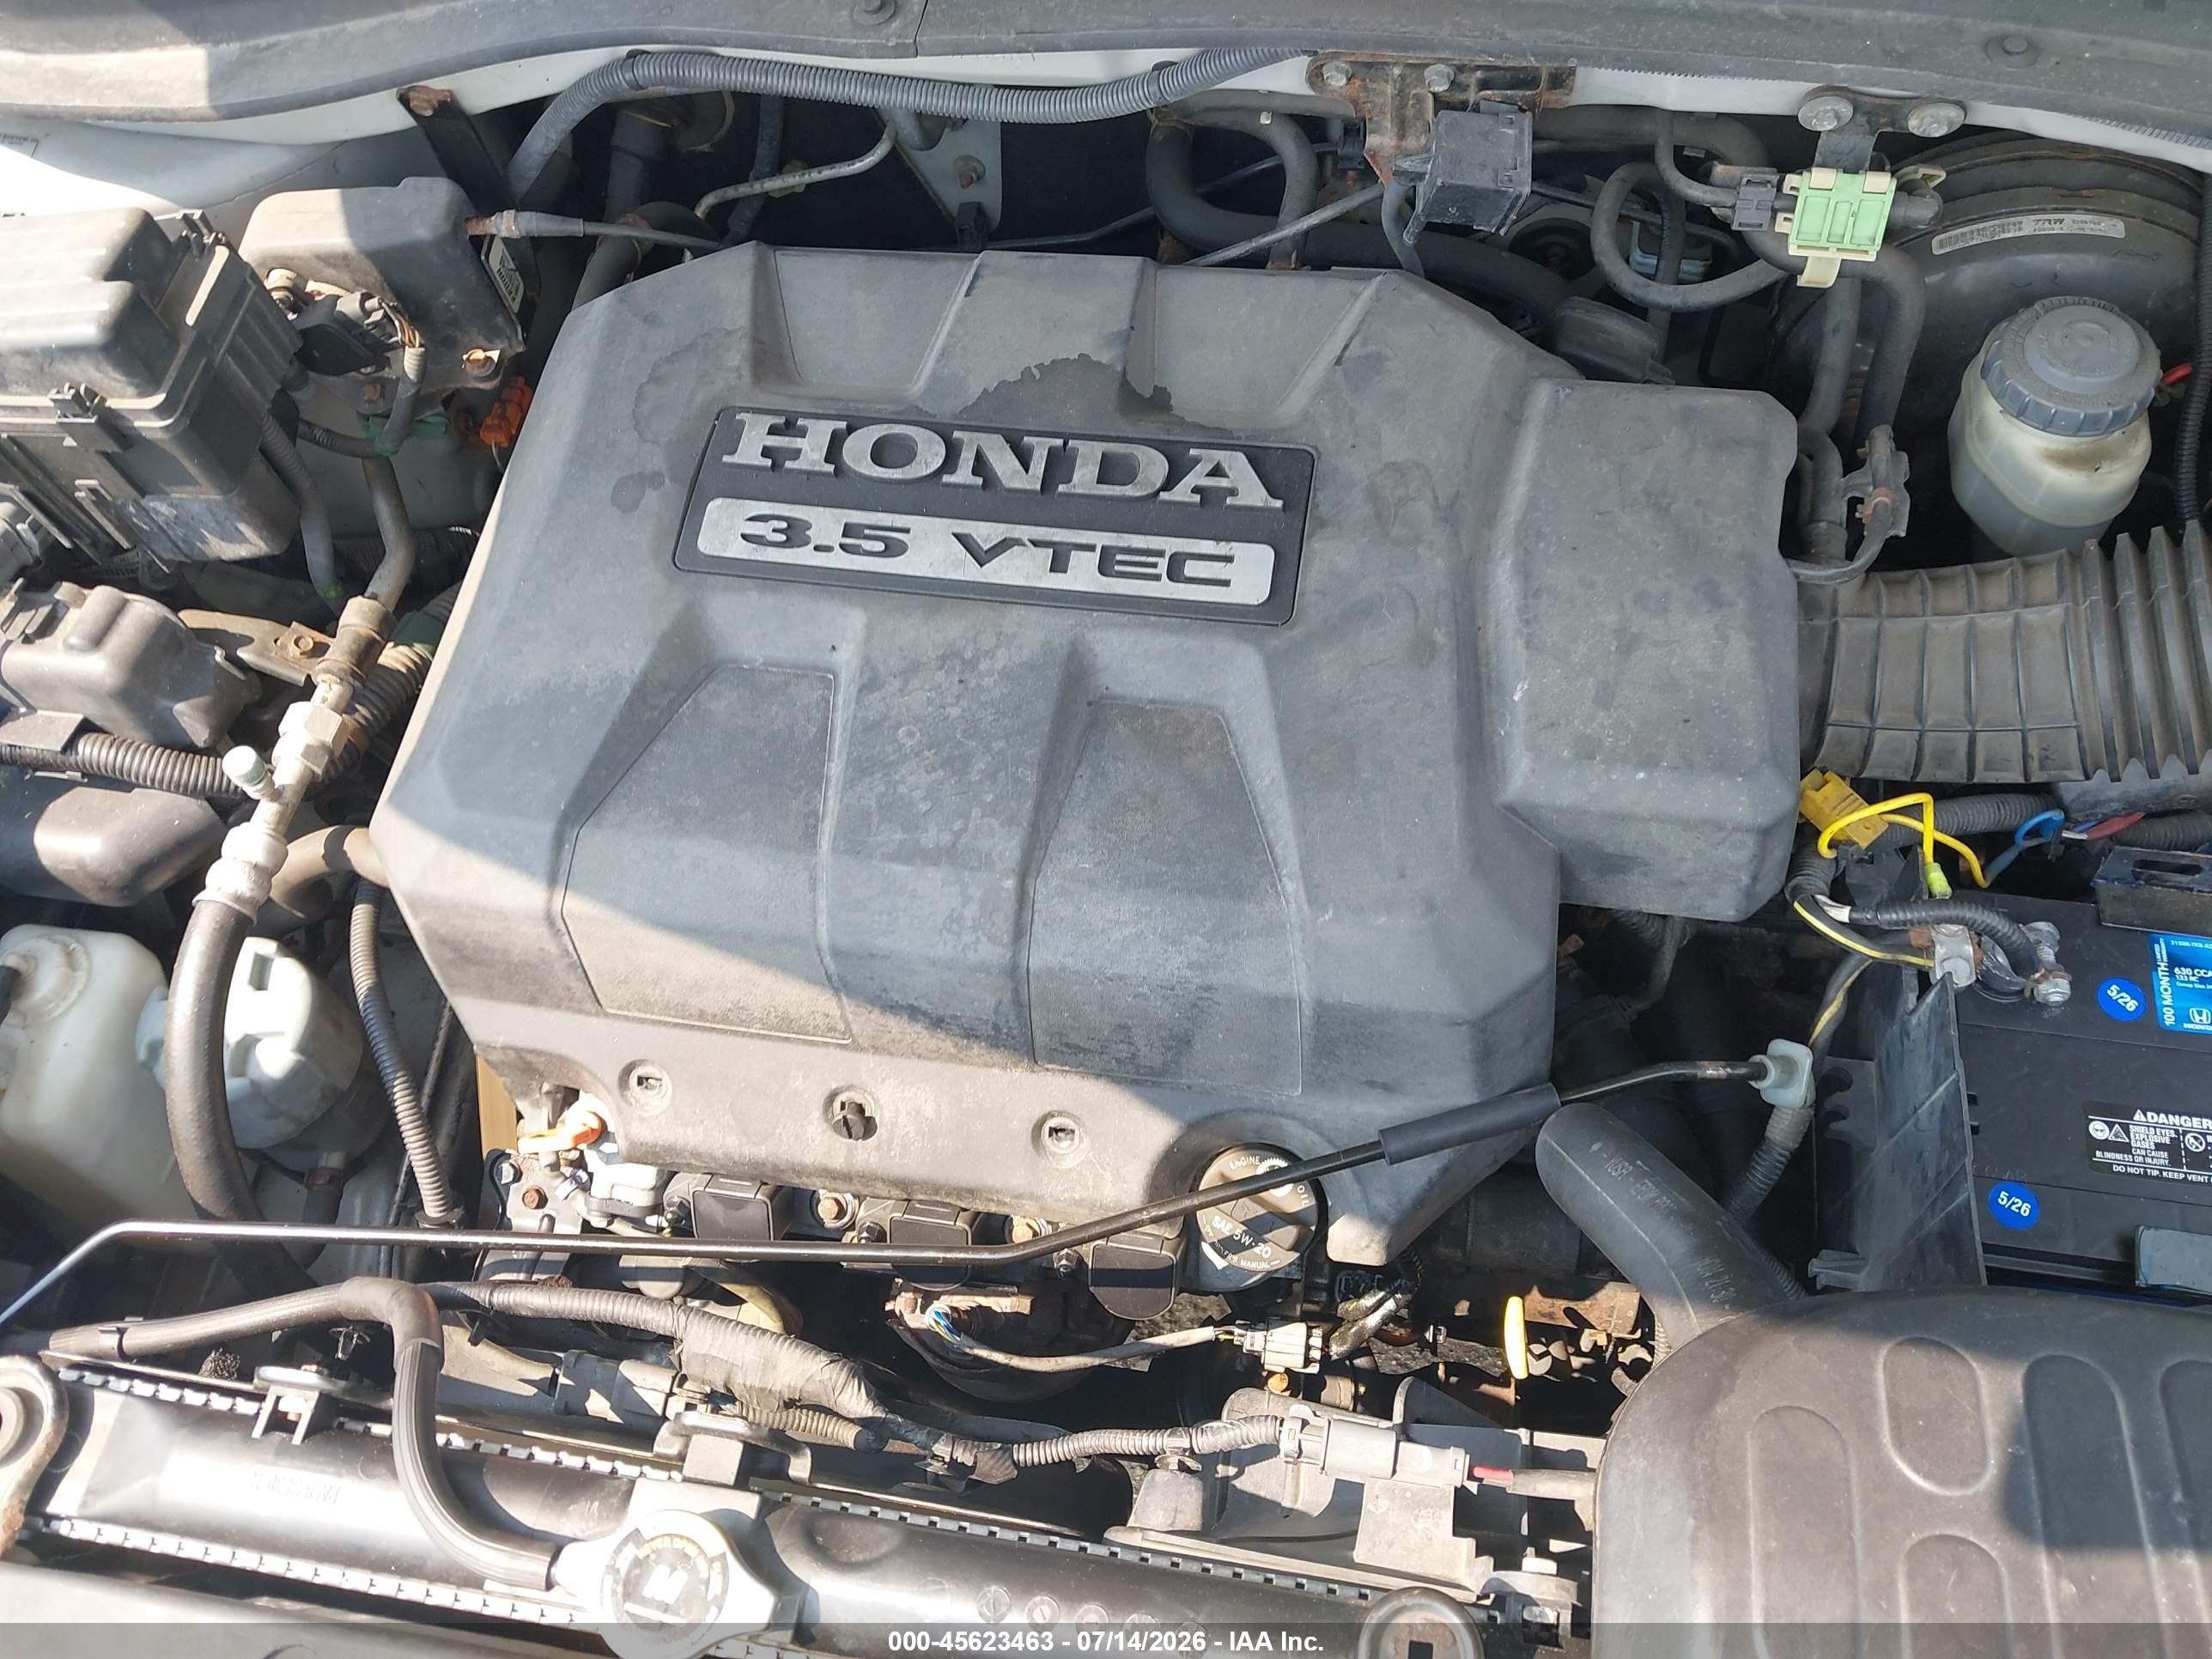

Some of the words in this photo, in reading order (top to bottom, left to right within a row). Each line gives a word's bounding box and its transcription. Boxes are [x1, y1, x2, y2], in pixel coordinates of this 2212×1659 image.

[722, 412, 1284, 510] HONDA
[739, 514, 912, 559] 3.5
[951, 532, 1236, 587] VTEC
[2174, 967, 2192, 975] 630
[2157, 962, 2173, 1006] MONTH
[2106, 984, 2139, 1012] 5/26
[2163, 1007, 2176, 1027] 100
[2147, 1112, 2212, 1129] DANGER
[2129, 1125, 2155, 1135] SHIELD
[2130, 1133, 2171, 1144] EXPLOSIVE
[2131, 1140, 2155, 1149] GASES
[2095, 1151, 2133, 1162] BLINDNESS
[2147, 1150, 2169, 1158] CAUSE
[1229, 1156, 1261, 1170] ENGINE
[1297, 1185, 1310, 1207] OIL
[2126, 1166, 2144, 1175] NOT
[2146, 1168, 2161, 1177] TIP.
[2162, 1170, 2185, 1180] KEEP
[2186, 1174, 2209, 1183] VENT
[1997, 1190, 2032, 1217] 5/26
[1212, 1214, 1234, 1235] SAE
[1233, 1230, 1273, 1259] 5W-20
[1240, 1258, 1271, 1269] MANUAL
